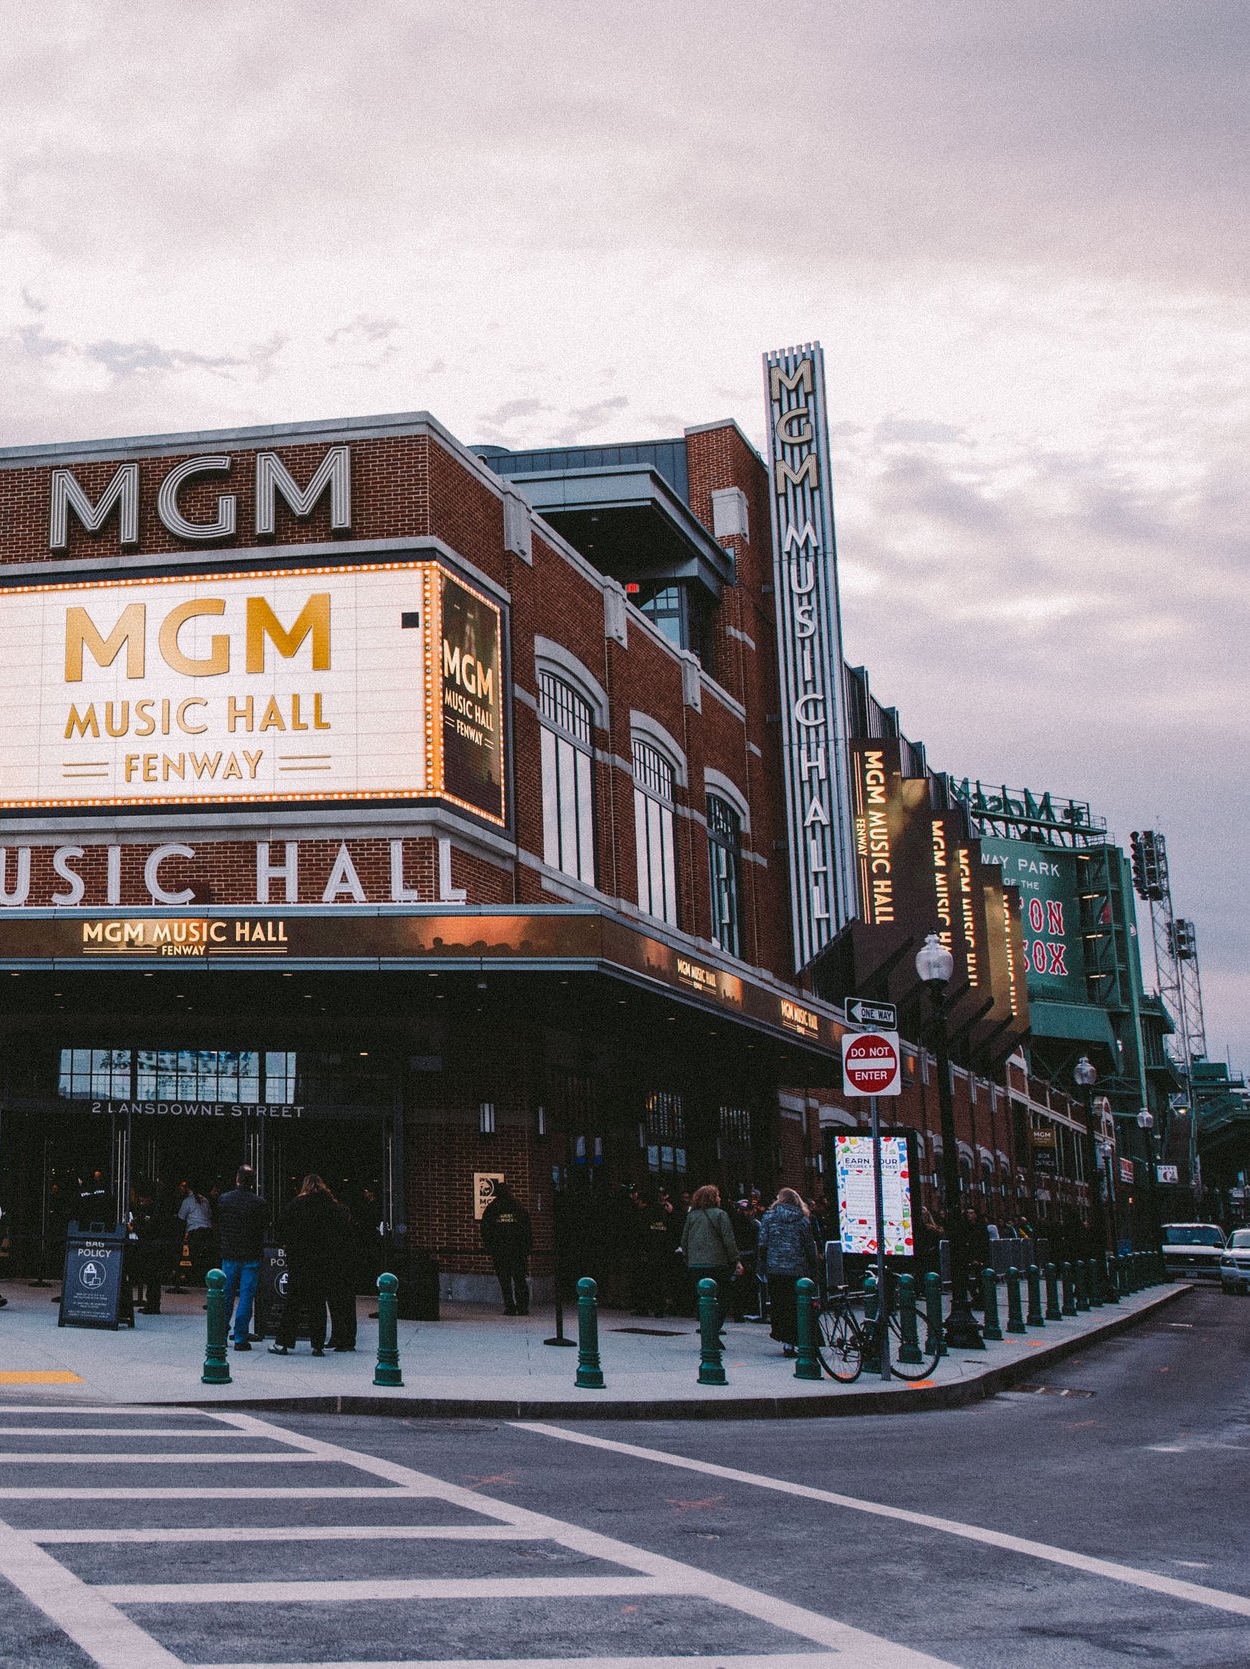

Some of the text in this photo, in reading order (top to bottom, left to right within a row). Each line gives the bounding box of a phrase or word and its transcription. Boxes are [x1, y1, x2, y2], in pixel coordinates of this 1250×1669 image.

[49, 444, 351, 551] MGM
[64, 592, 332, 682] MGM
[769, 358, 830, 921] MGM MUSIC HALL
[443, 638, 494, 706] MGM
[64, 691, 331, 739] MUSIC HALL
[444, 687, 494, 732] MUSIC HALL
[456, 719, 483, 746] FENWAY
[124, 749, 264, 783] FENWAY
[855, 818, 869, 856] FENWAY
[864, 750, 895, 926] MGM MUSIC HALL
[255, 837, 467, 904] HALL
[1003, 877, 1040, 890] OF THE
[1017, 859, 1062, 878] PARK
[82, 921, 288, 942] MGM MUSIC HALL
[161, 945, 206, 956] FENWAY
[860, 1007, 894, 1022] ONE WAY
[850, 1046, 890, 1058] DO NOT
[855, 1070, 888, 1081] ENTER
[91, 1102, 305, 1118] 2 LANSDOWNE STREET
[77, 1248, 112, 1258] POLICY
